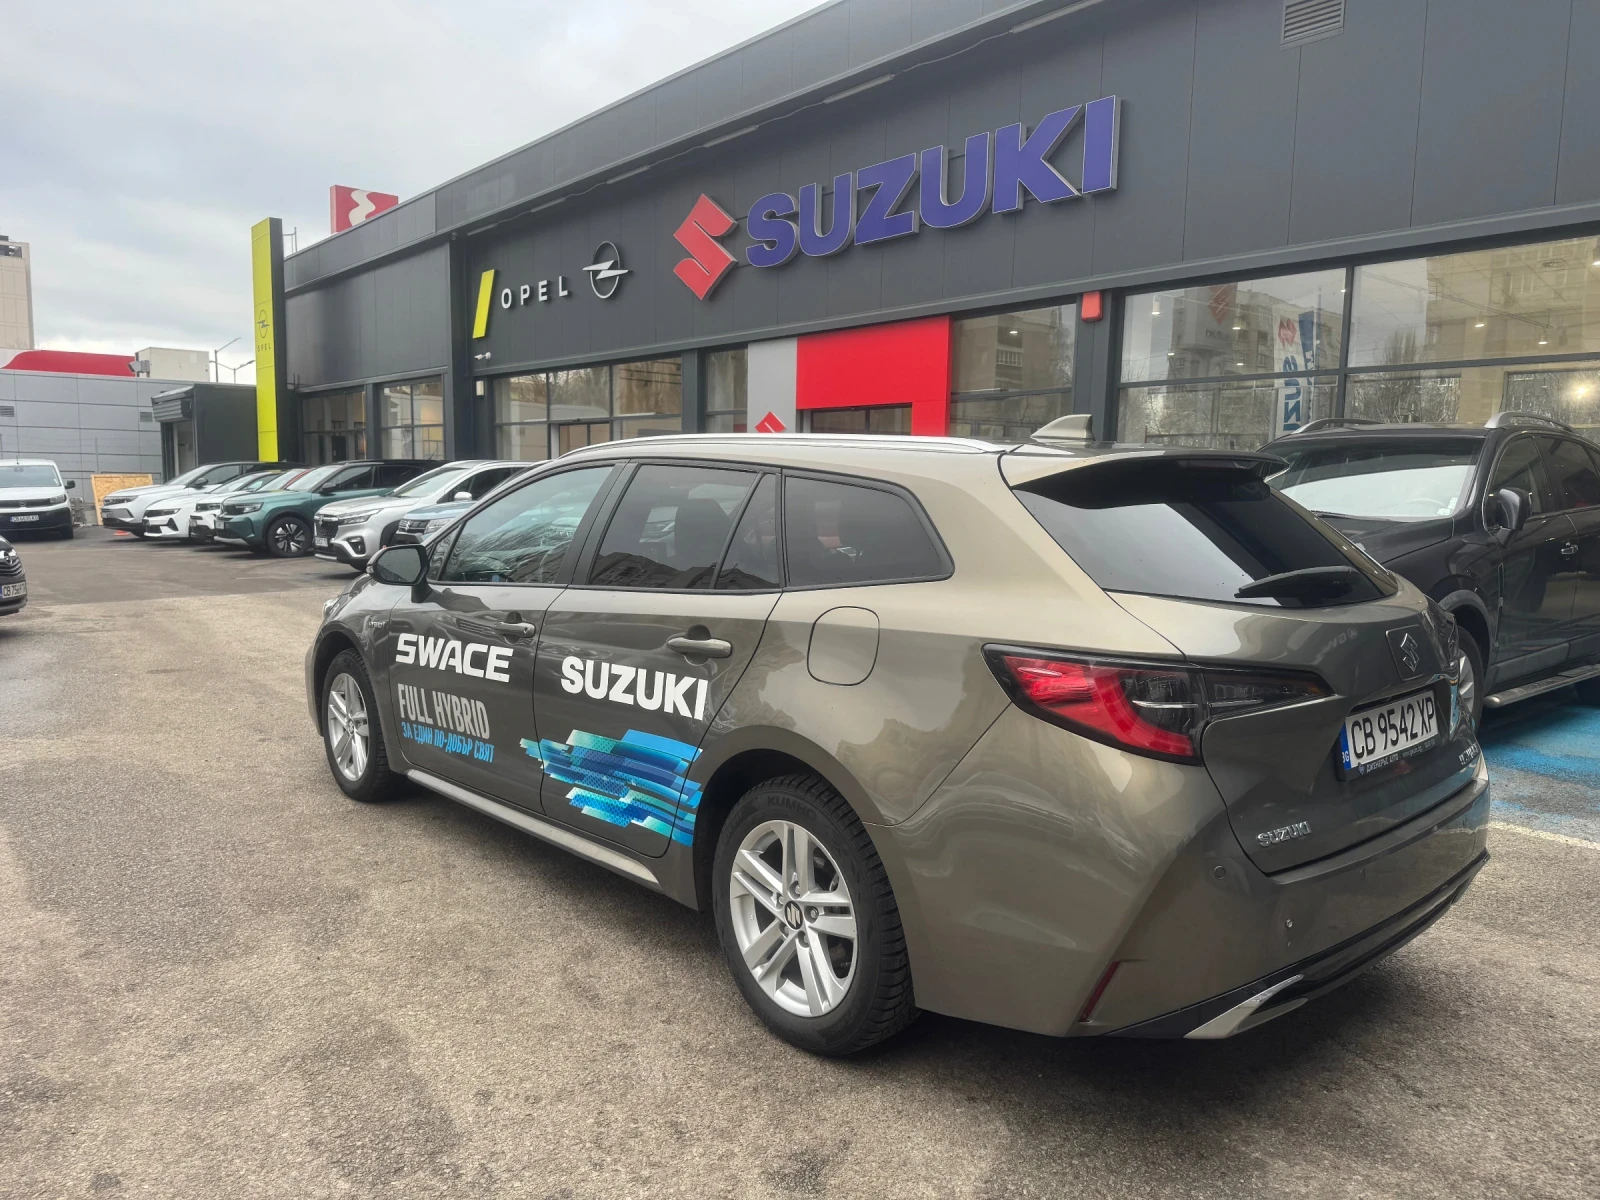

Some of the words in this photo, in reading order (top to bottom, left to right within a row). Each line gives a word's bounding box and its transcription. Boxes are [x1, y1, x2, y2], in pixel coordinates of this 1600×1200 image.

[746, 95, 1119, 268] SUZUKI
[501, 275, 569, 309] OPEL
[395, 632, 514, 682] SWACE
[397, 683, 434, 725] FULL
[432, 690, 490, 739] HYBRID
[560, 656, 708, 721] SUZUKI
[401, 721, 413, 739] ЗА
[413, 723, 433, 745] ЕДИН
[434, 729, 473, 756] ПО-ДОБЪР
[473, 740, 495, 763] СВЯТ
[1351, 717, 1376, 759] CB
[1377, 704, 1418, 750] 9542
[1417, 697, 1435, 736] XP
[1256, 821, 1311, 847] SUZUKI
